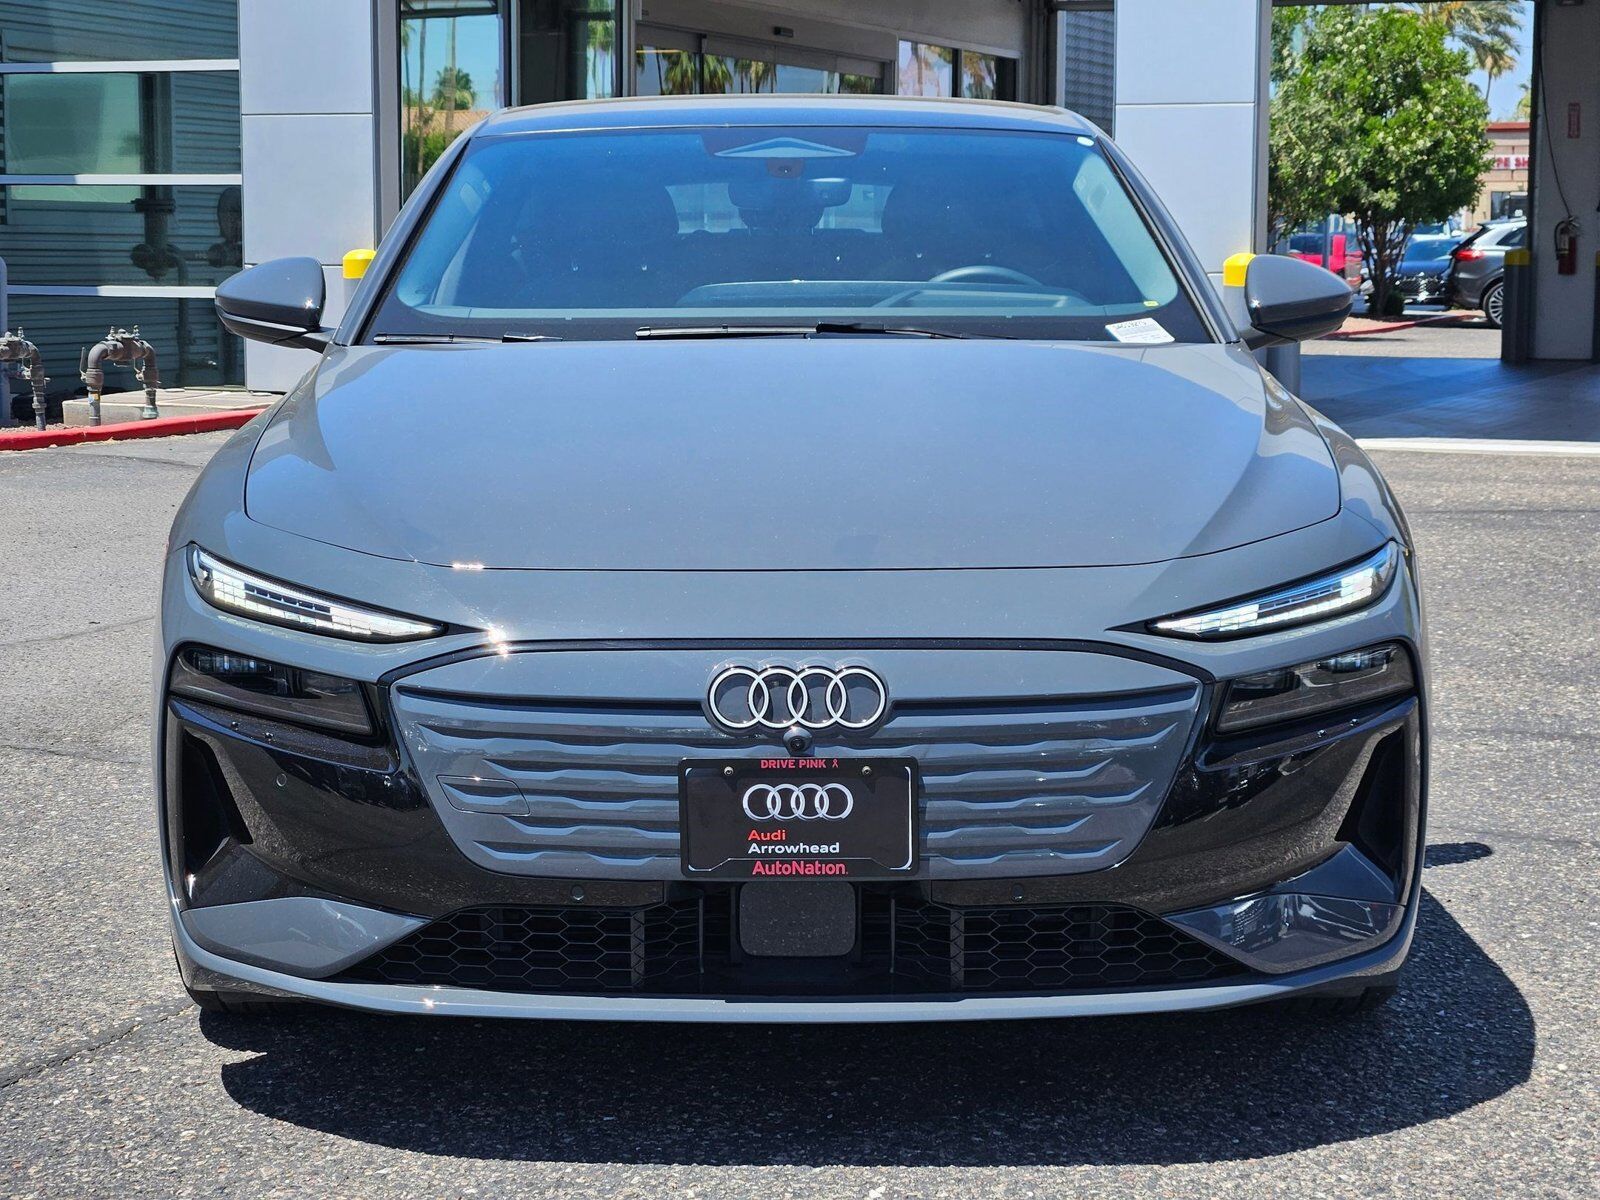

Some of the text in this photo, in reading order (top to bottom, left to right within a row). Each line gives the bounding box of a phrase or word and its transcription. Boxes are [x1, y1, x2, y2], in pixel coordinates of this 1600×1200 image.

[760, 759, 827, 769] DRIVE PINK
[748, 829, 786, 841] Audi
[748, 842, 840, 854] Arrowhead
[752, 860, 847, 876] AutoNation
